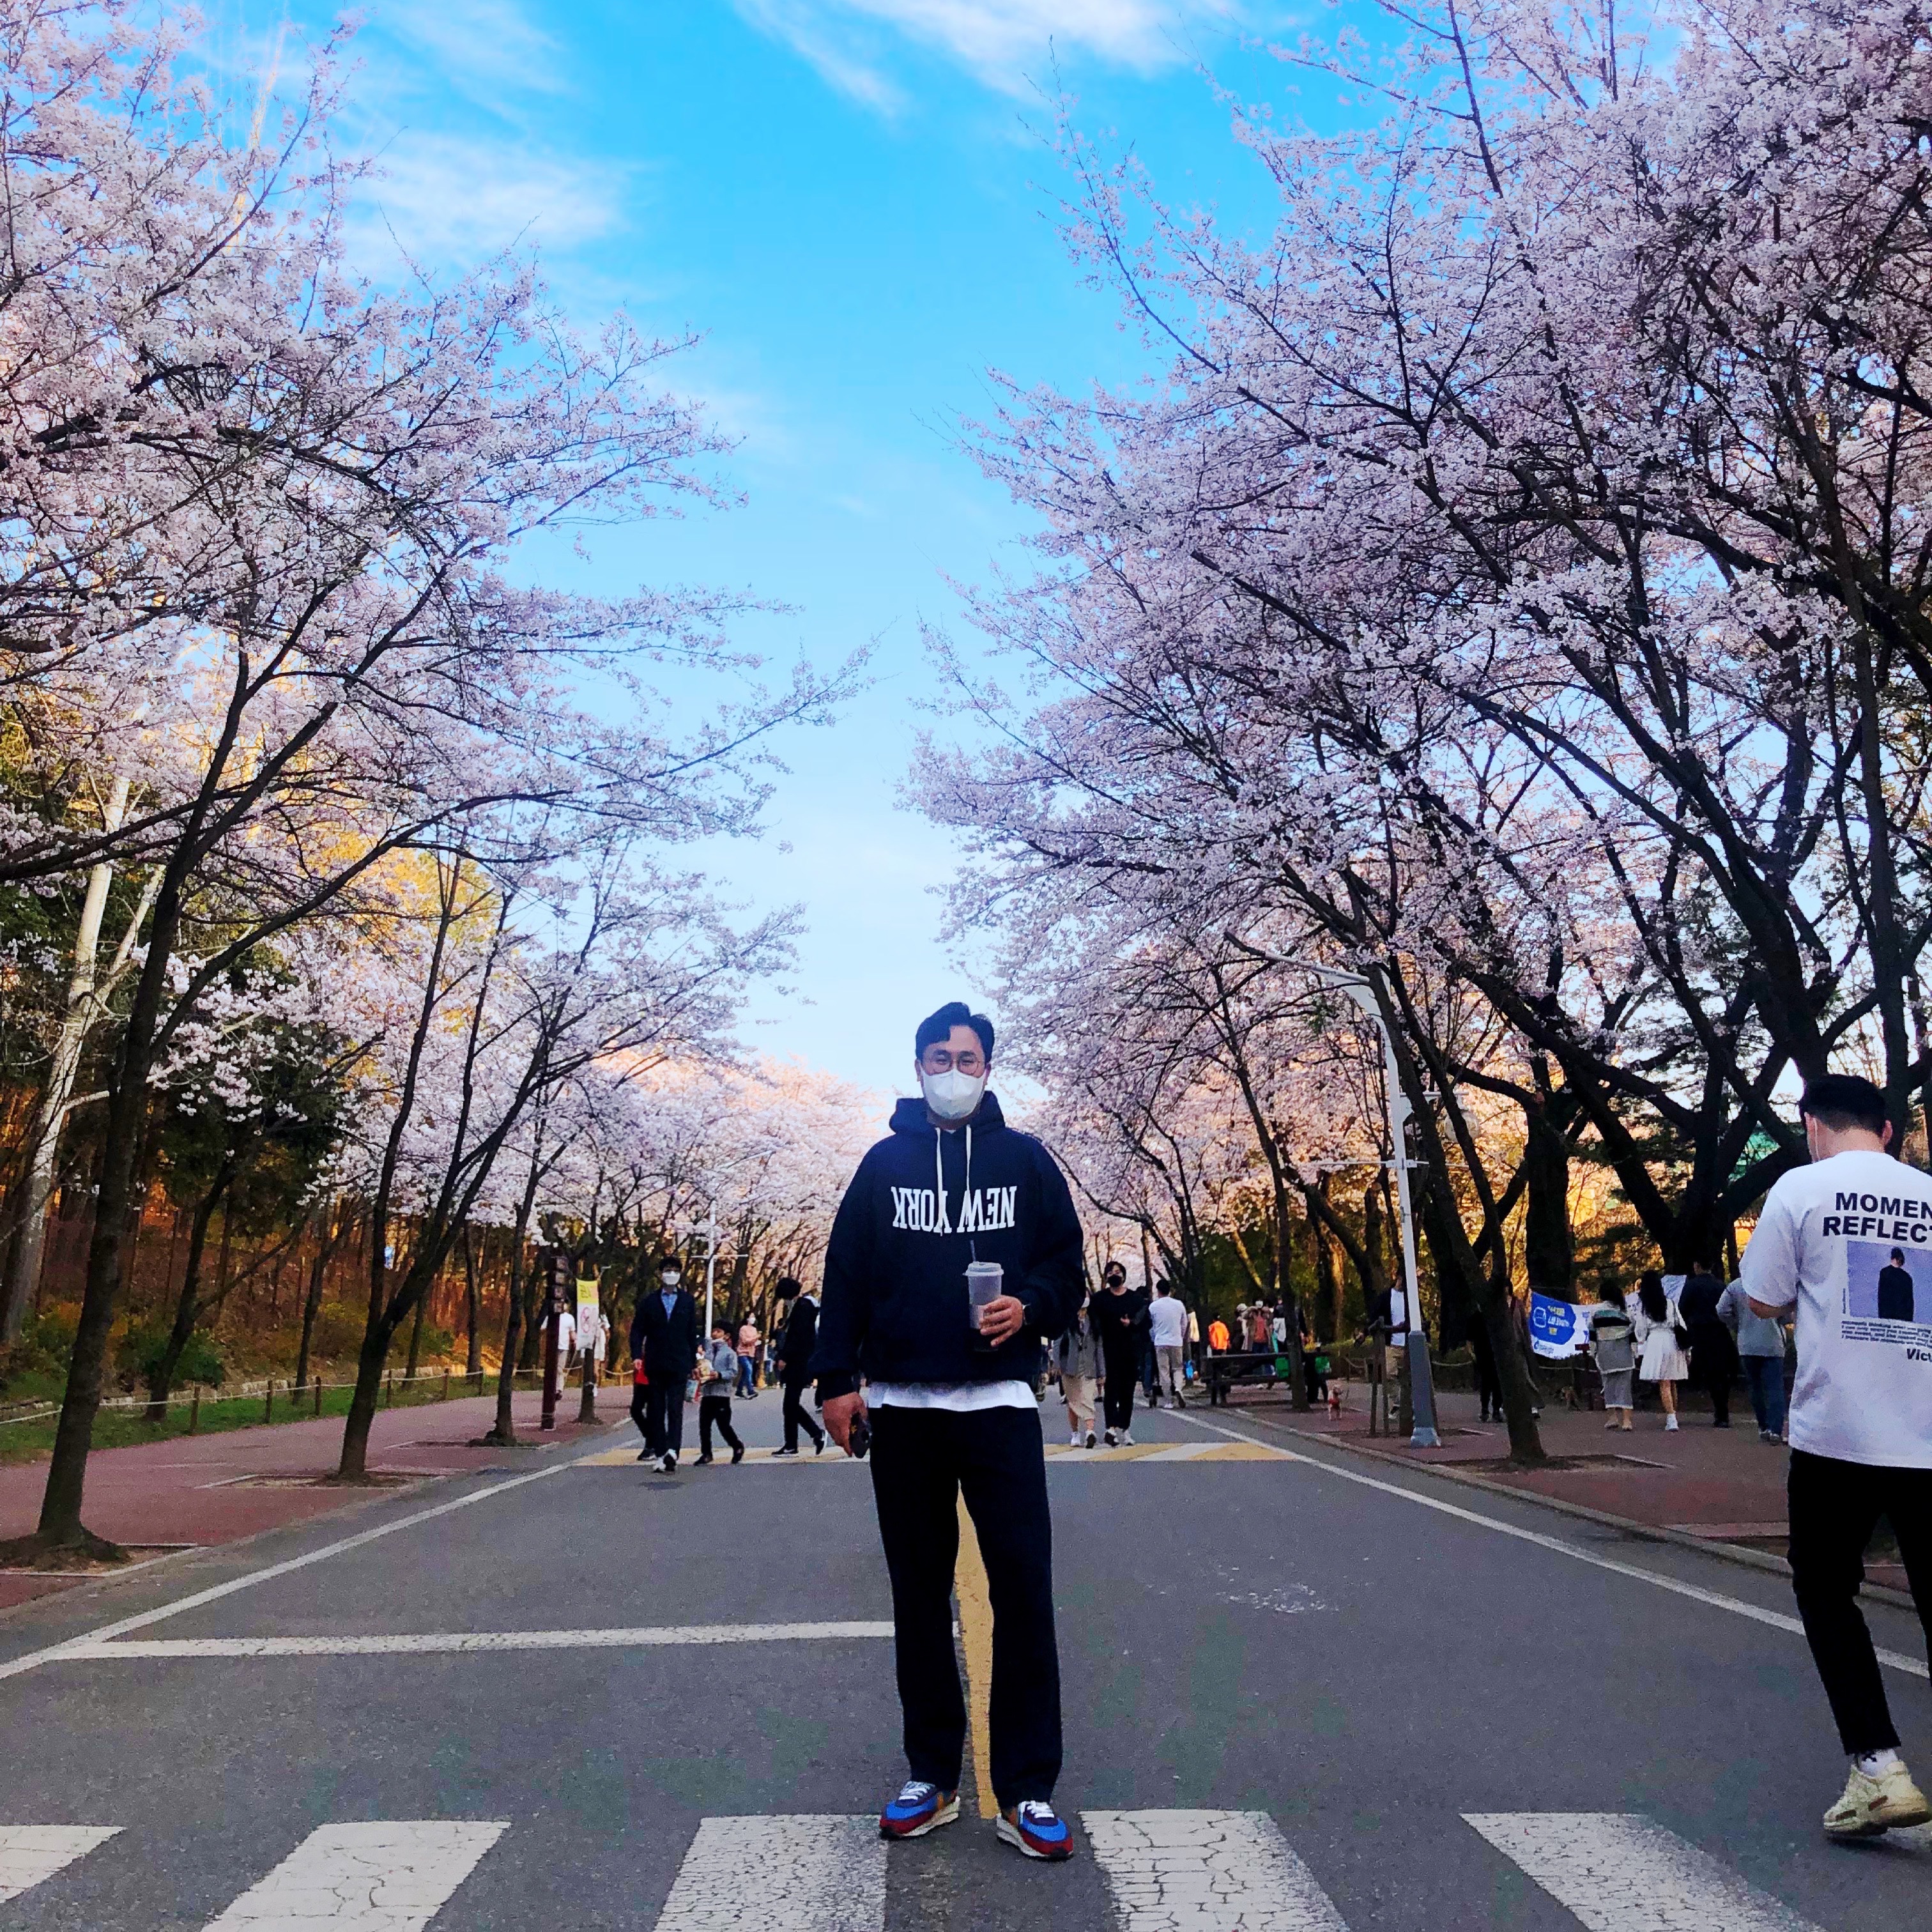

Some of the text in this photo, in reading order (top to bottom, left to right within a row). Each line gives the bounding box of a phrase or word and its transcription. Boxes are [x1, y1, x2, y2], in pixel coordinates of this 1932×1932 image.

[891, 1186, 1017, 1234] NEW YORK
[1822, 1216, 1932, 1243] REFLEC
